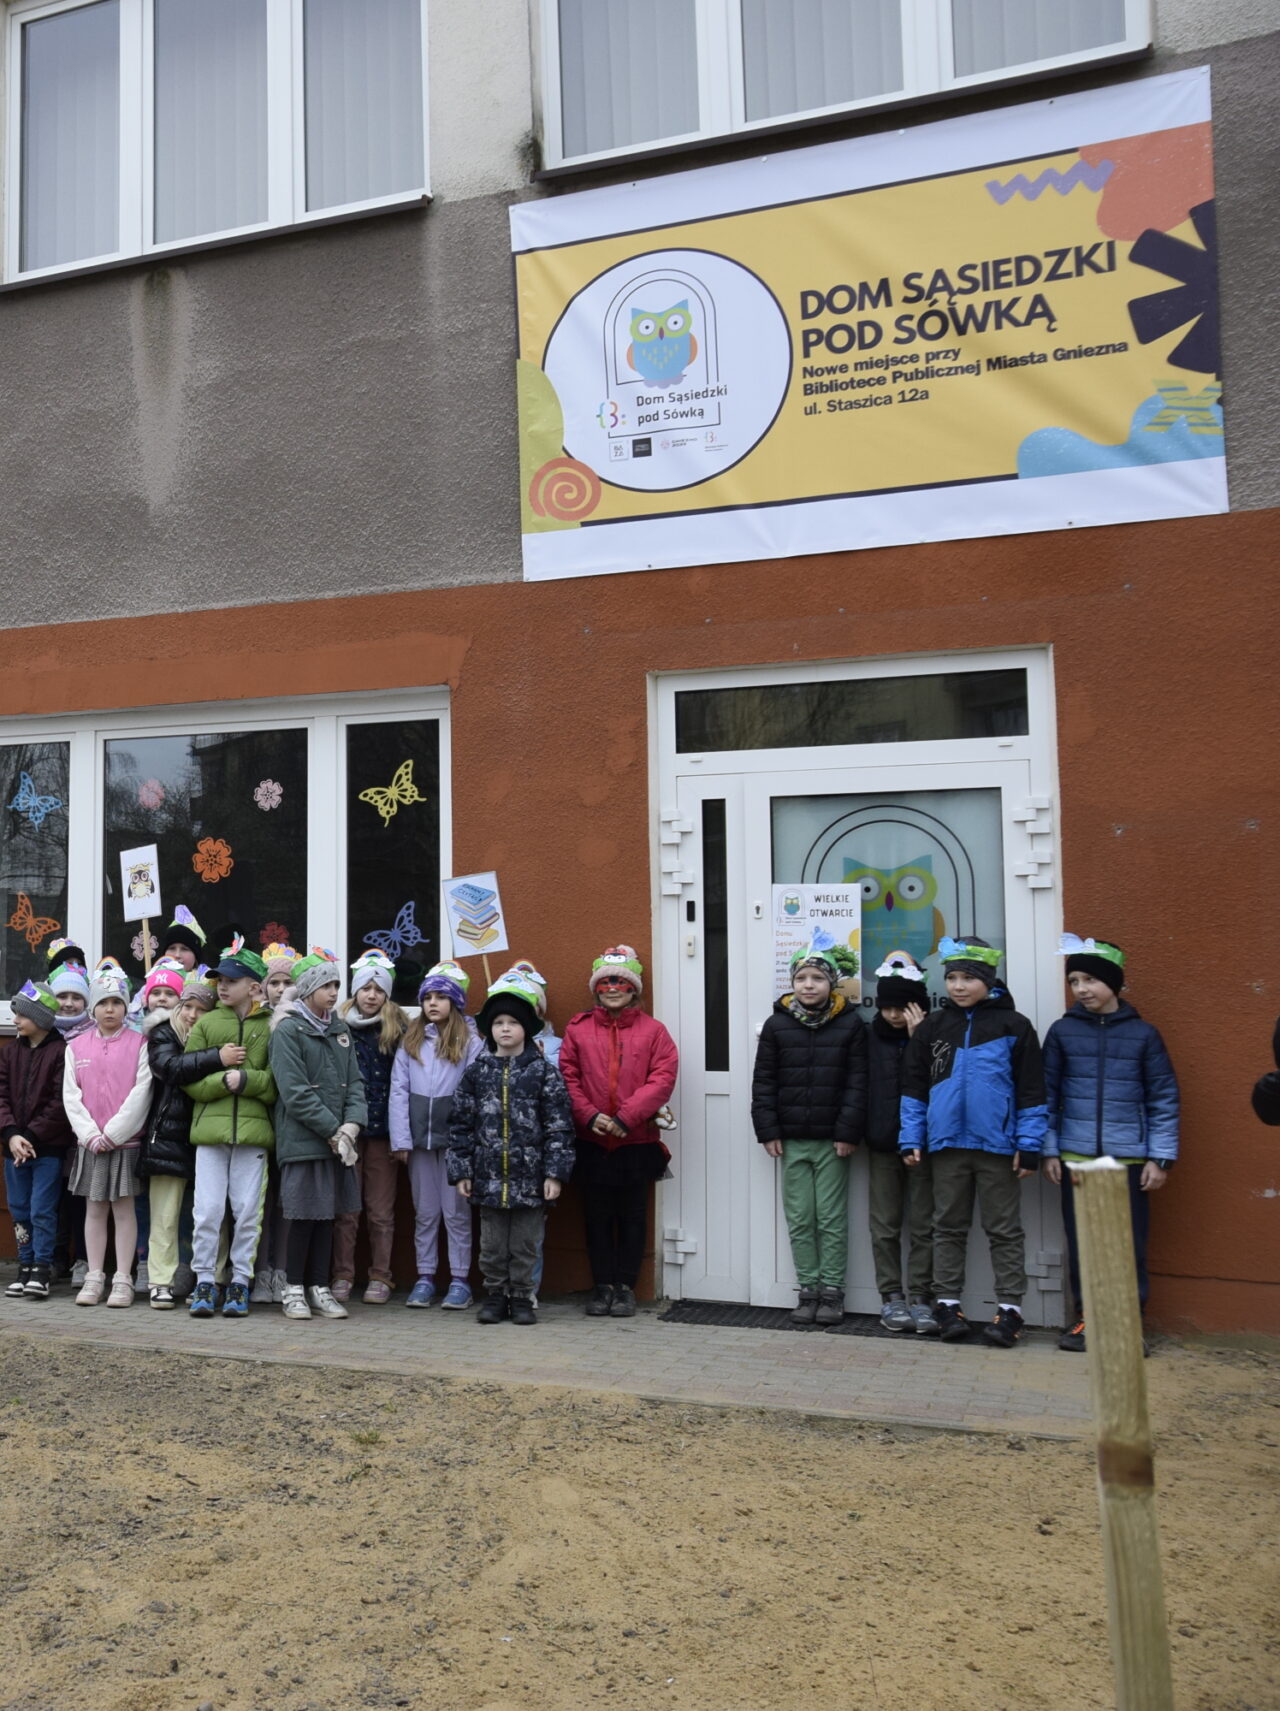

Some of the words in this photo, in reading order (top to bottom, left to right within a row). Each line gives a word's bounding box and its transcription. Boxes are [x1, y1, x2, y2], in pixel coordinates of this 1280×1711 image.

[800, 277, 892, 320] DOM
[901, 240, 1117, 306] SĄSIEDZKI
[801, 319, 883, 359] POD
[892, 293, 1058, 345] SÓWKĄ
[802, 360, 849, 379] Nowe
[853, 352, 920, 374] miejsce
[925, 348, 961, 366] przy
[803, 372, 887, 396] Bibliotece
[891, 360, 982, 385] Publicznej
[986, 350, 1048, 372] Miasta
[1053, 340, 1129, 362] Gniezna
[636, 395, 664, 407] Dom
[668, 385, 728, 404] Sąsiedzki
[804, 400, 822, 416] ul.
[827, 393, 893, 414] Staszica
[898, 388, 930, 403] 12a
[638, 410, 660, 427] pod
[663, 407, 705, 420] Sówką
[814, 894, 850, 903] WIELKIE
[809, 909, 854, 918] OTWARCIE
